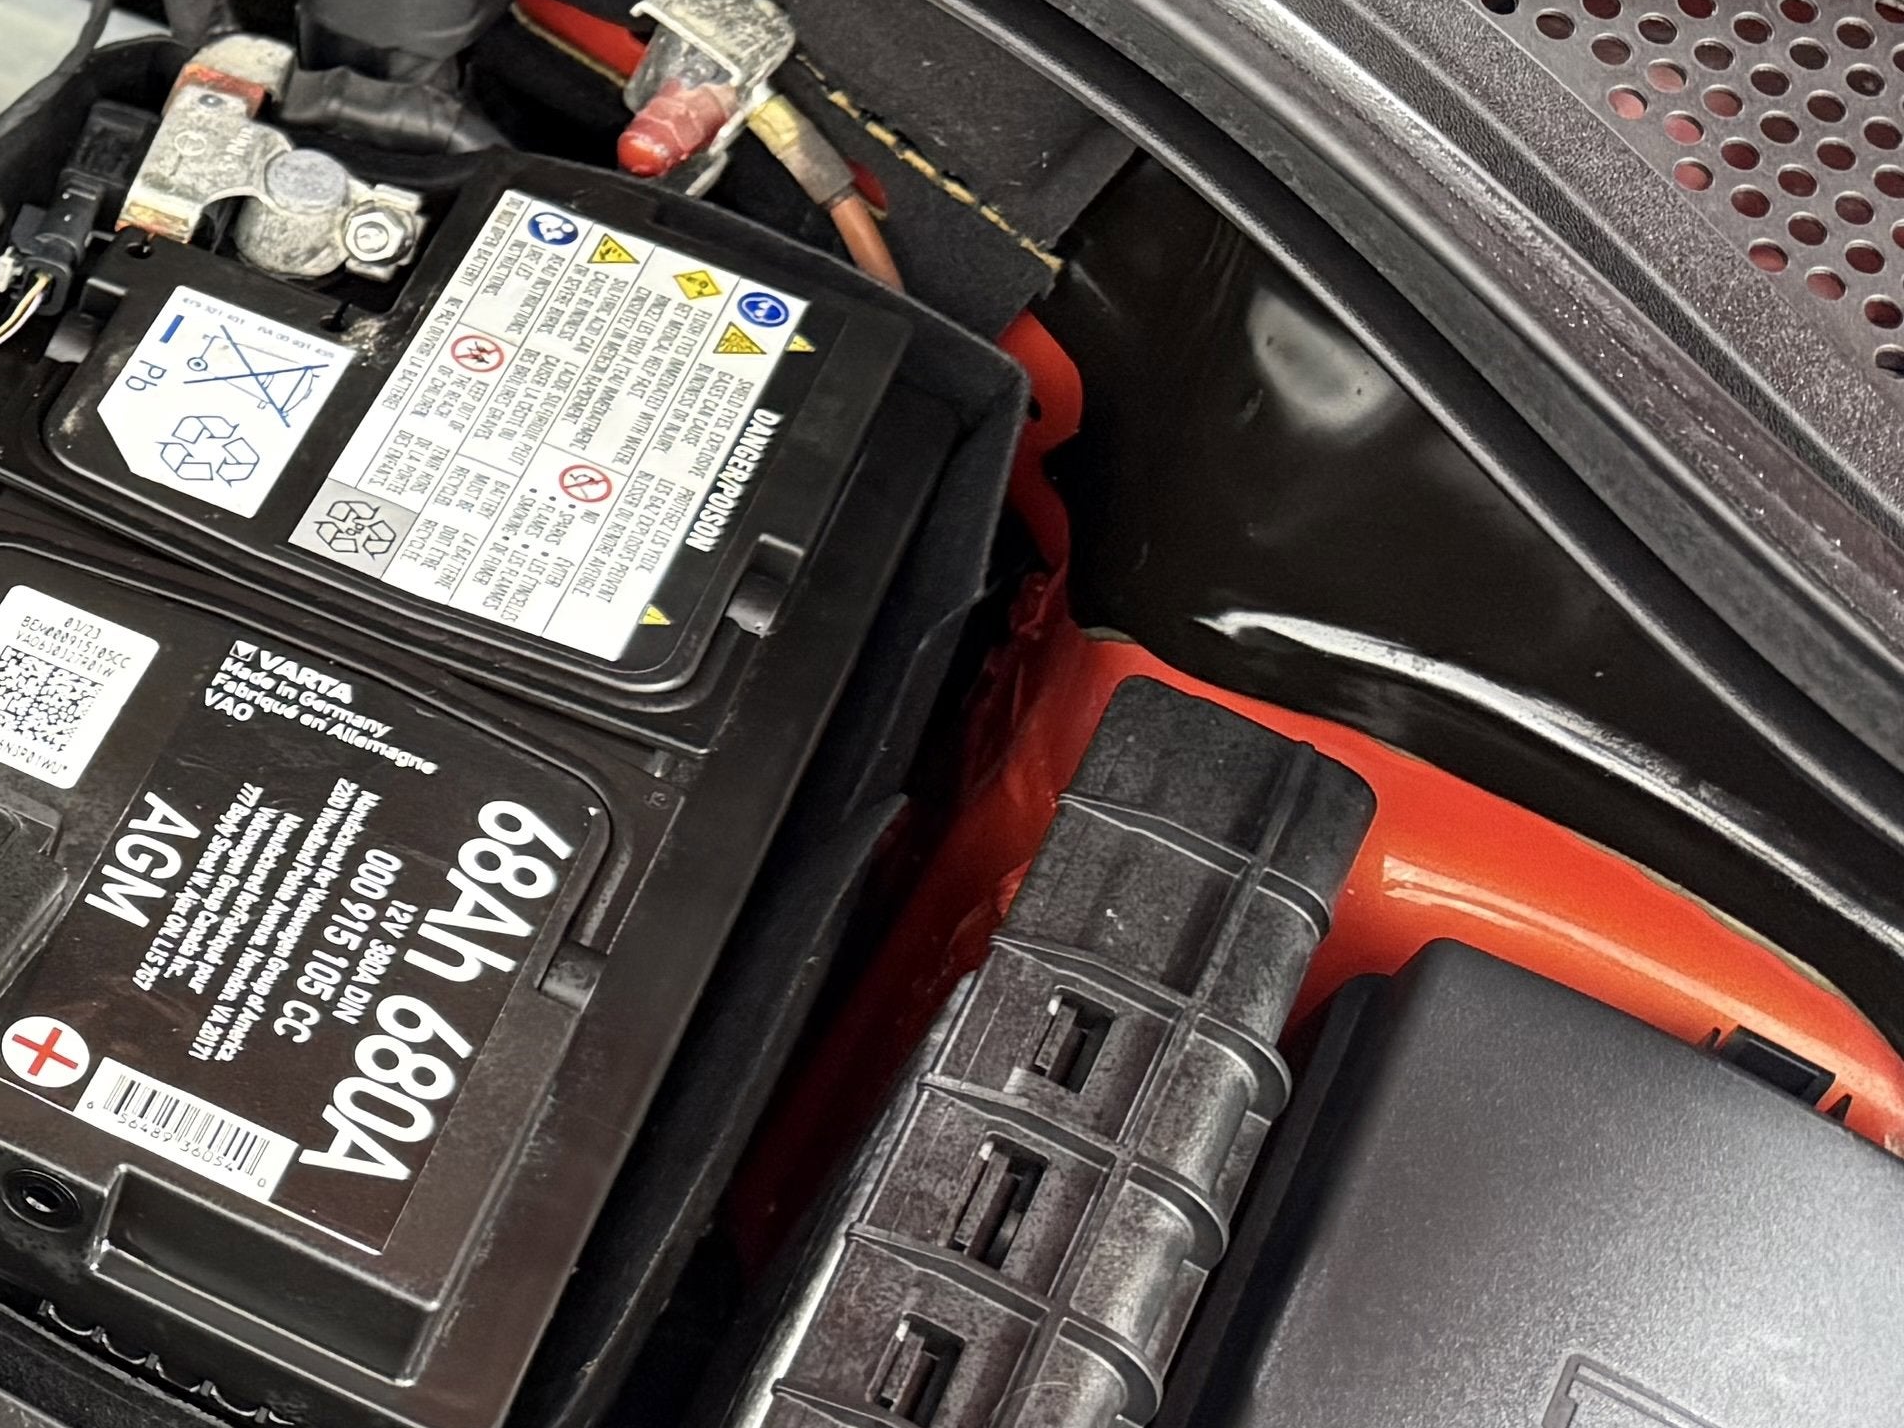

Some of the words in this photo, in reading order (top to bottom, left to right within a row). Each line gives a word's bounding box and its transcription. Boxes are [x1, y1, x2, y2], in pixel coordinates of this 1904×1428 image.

[123, 356, 166, 398] Pb
[435, 364, 454, 378] OF
[450, 372, 471, 390] THE
[465, 378, 489, 402] KEEP
[676, 362, 714, 409] BLINDNESS
[432, 389, 461, 419] REACH
[454, 401, 476, 420] OUT
[521, 386, 541, 401] LA
[446, 419, 465, 433] OF
[497, 426, 517, 441] OU
[521, 391, 562, 442] SULFURIQUE
[669, 407, 689, 422] OR
[680, 416, 708, 447] CAUSE
[392, 429, 414, 447] DES
[404, 449, 424, 463] LA
[412, 436, 432, 450] DE
[507, 441, 533, 466] PEUT
[687, 430, 726, 479] EXPLOSIVE
[366, 446, 403, 489] ENFANTS.
[423, 444, 450, 471] TENIR
[408, 470, 434, 495] HORS
[461, 471, 490, 501] MUST
[621, 469, 655, 508] BLESSER
[652, 477, 675, 496] LES
[682, 404, 783, 555] DANGER/POISON
[454, 498, 474, 513] BE
[474, 479, 510, 520] BATTERY
[500, 493, 536, 536] SMOKING
[579, 508, 600, 524] NO
[613, 506, 634, 522] OU
[642, 494, 666, 516] GAZ
[433, 524, 459, 547] DOIT
[523, 501, 556, 539] FLAMES
[542, 509, 575, 546] SPARKS
[594, 520, 627, 557] RENDRE
[649, 529, 673, 549] LES
[458, 532, 479, 547] LA
[488, 541, 509, 557] DE
[506, 549, 528, 568] LES
[433, 545, 472, 590] BATTERIE
[471, 554, 501, 586] FUMER
[525, 557, 548, 576] LES
[571, 555, 607, 599] AVEUGLE.
[594, 560, 630, 603] PEUVENT
[481, 565, 519, 611] FLAMMES
[63, 615, 101, 640] 03/23
[254, 648, 357, 705] VARTA
[218, 655, 278, 692] Made
[274, 678, 299, 701] in
[297, 687, 394, 739] Germany
[209, 670, 301, 723] Fabriqué
[297, 706, 329, 735] en
[325, 718, 440, 780] Allemagne
[230, 778, 261, 807] 777
[324, 776, 359, 812] 2200
[213, 799, 250, 840] Bayly
[293, 803, 344, 869] Woodland
[319, 787, 382, 873] Manufactured
[193, 832, 232, 875] Street
[220, 801, 278, 878] Volkswagen
[240, 809, 303, 896] Manufactured
[82, 789, 209, 931] AGM
[309, 865, 338, 891] for
[346, 845, 405, 903] 000
[200, 870, 240, 916] Group
[272, 859, 311, 904] Pointe
[402, 790, 581, 1002] 68Ah
[169, 884, 204, 919] Ajax
[376, 897, 419, 940] 12V
[176, 908, 220, 960] Canada
[271, 883, 328, 961] Volkswagen
[319, 894, 378, 953] 915
[130, 960, 163, 993] 7G7
[185, 960, 221, 998] pour
[250, 954, 290, 1000] Group
[292, 945, 350, 1003] 105
[349, 935, 398, 989] 380A
[205, 1000, 235, 1027] VA
[243, 992, 269, 1013] of
[268, 995, 323, 1046] CC
[330, 983, 372, 1025] DIN
[186, 1019, 225, 1062] 20171
[297, 986, 483, 1204] 680A
[85, 1099, 95, 1110] 6
[117, 1110, 173, 1145] 56489
[178, 1139, 236, 1173] 36054
[256, 1176, 267, 1188] 0
